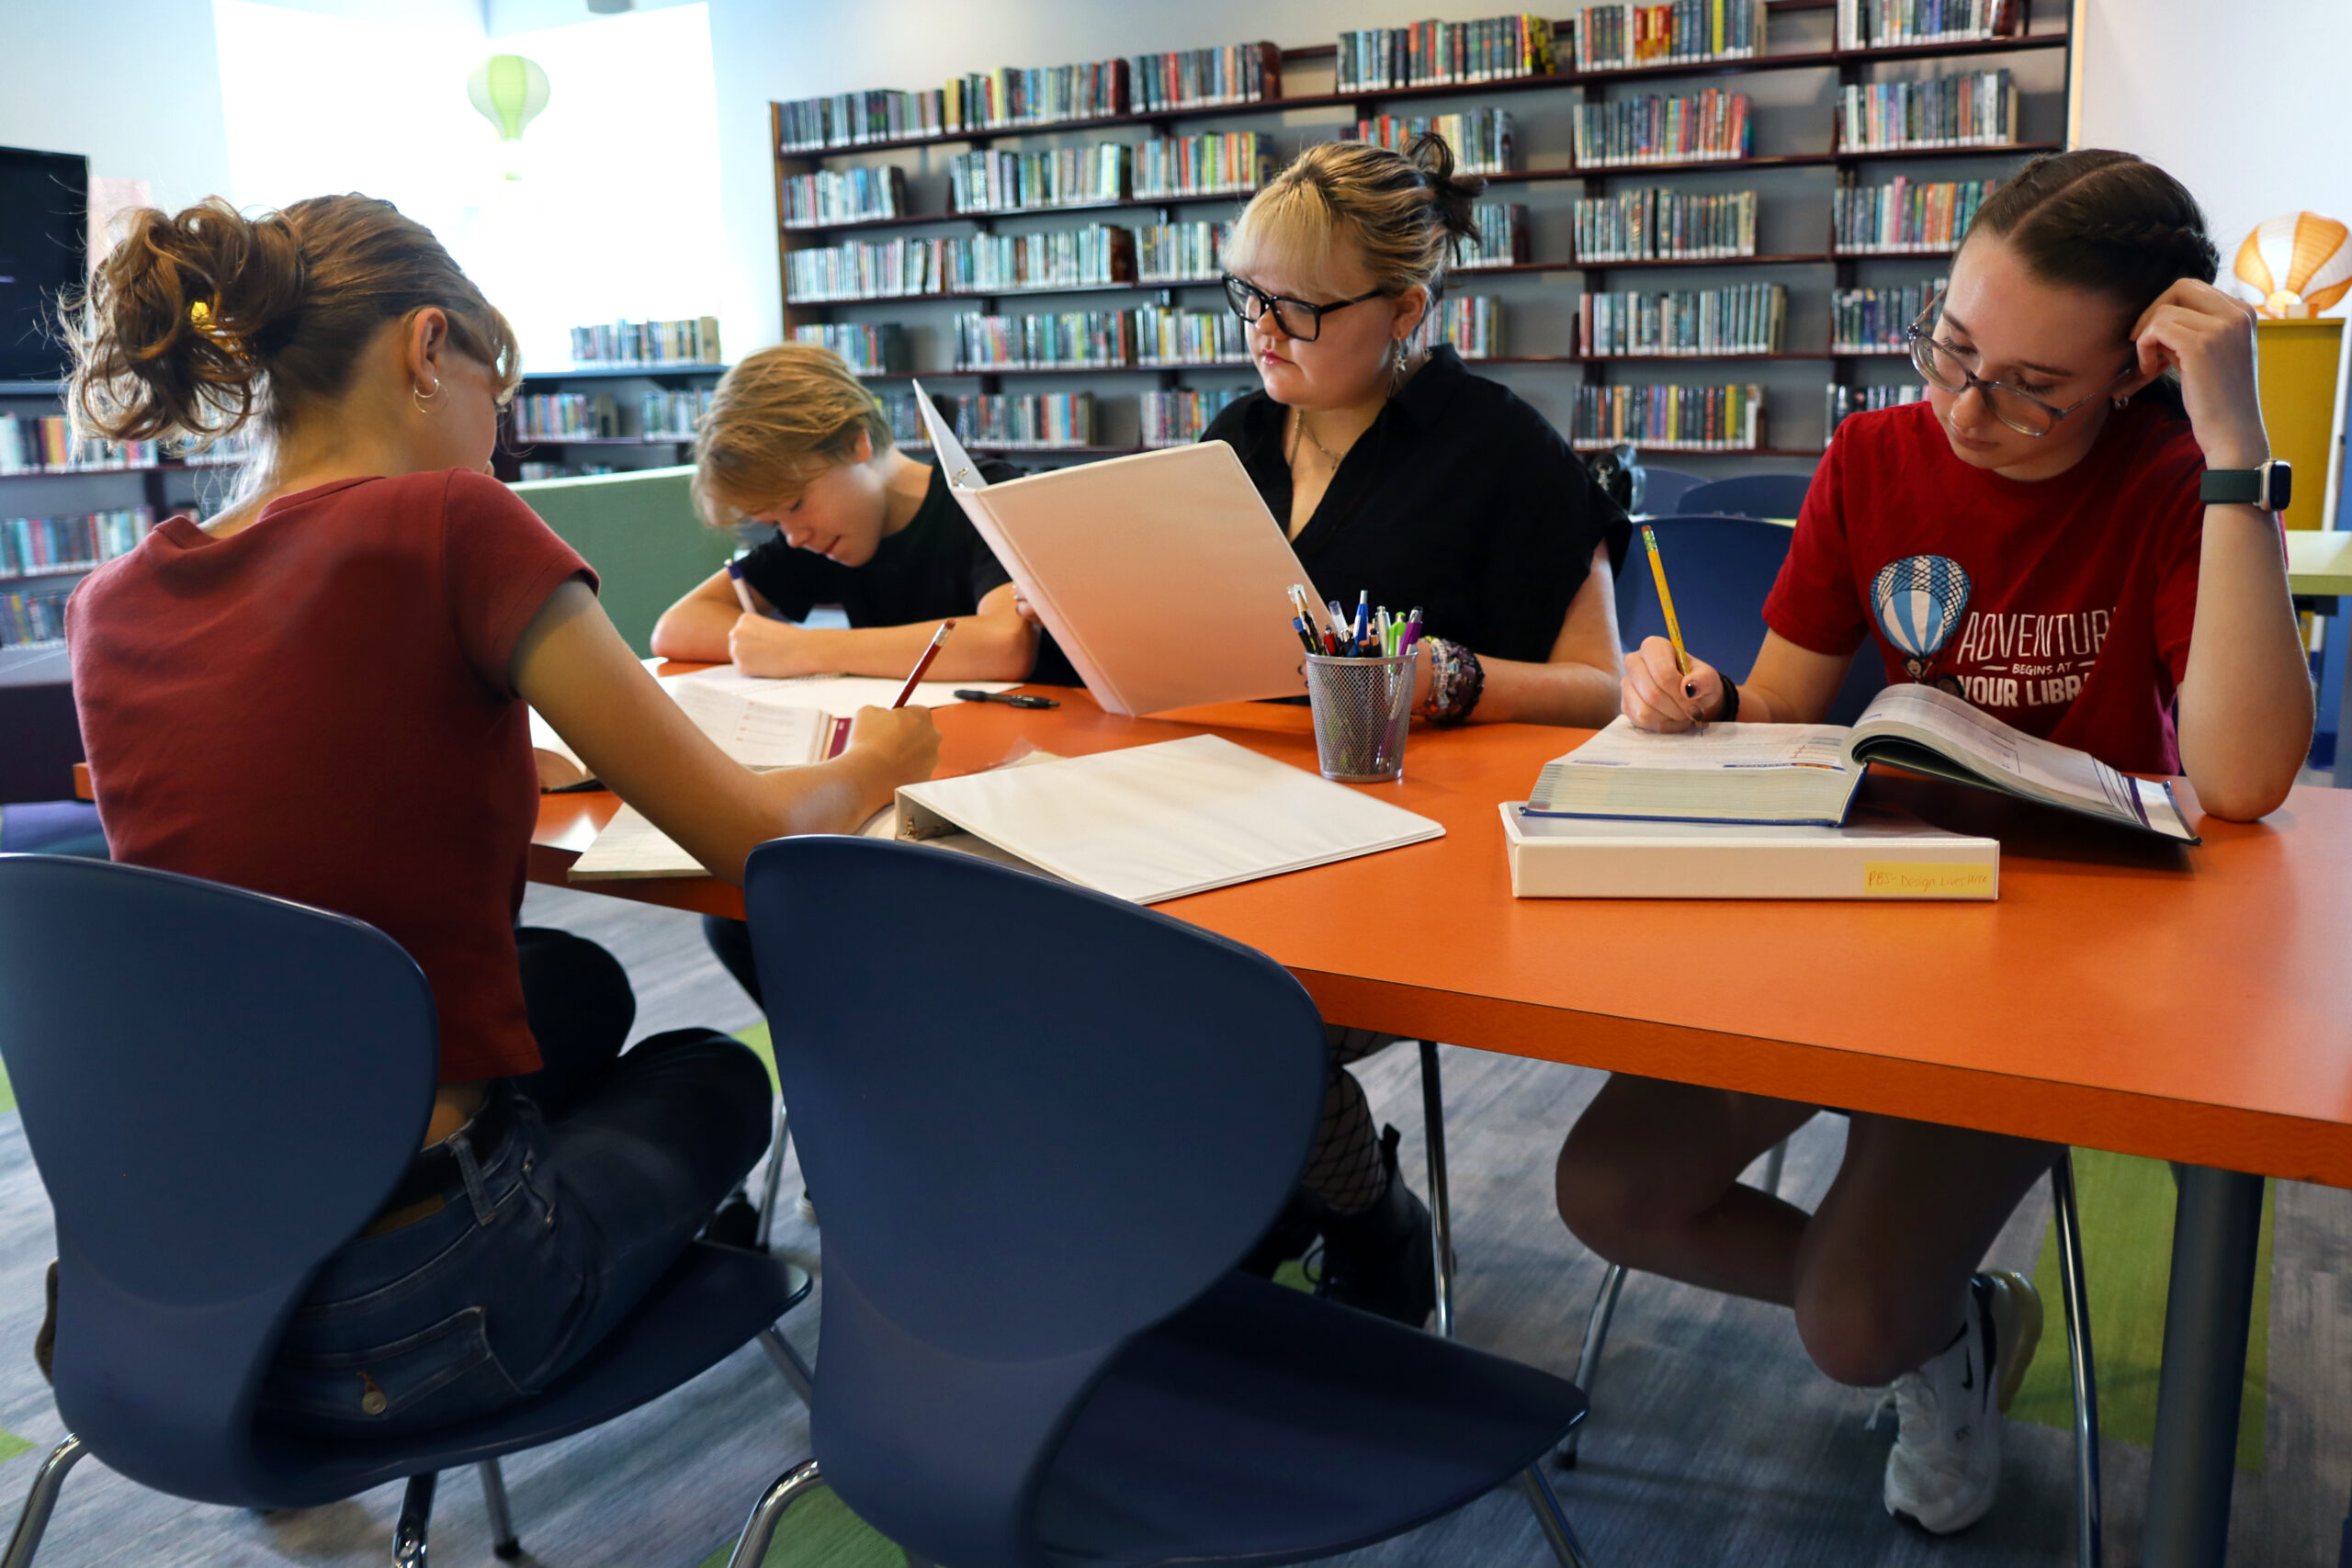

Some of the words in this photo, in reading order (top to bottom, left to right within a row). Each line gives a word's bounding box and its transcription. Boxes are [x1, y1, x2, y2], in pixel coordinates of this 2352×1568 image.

[1956, 607, 2117, 664] ADVENTUR
[2011, 662, 2053, 676] BEGINS
[2056, 660, 2073, 673] AT
[1957, 674, 2019, 707] YOUR
